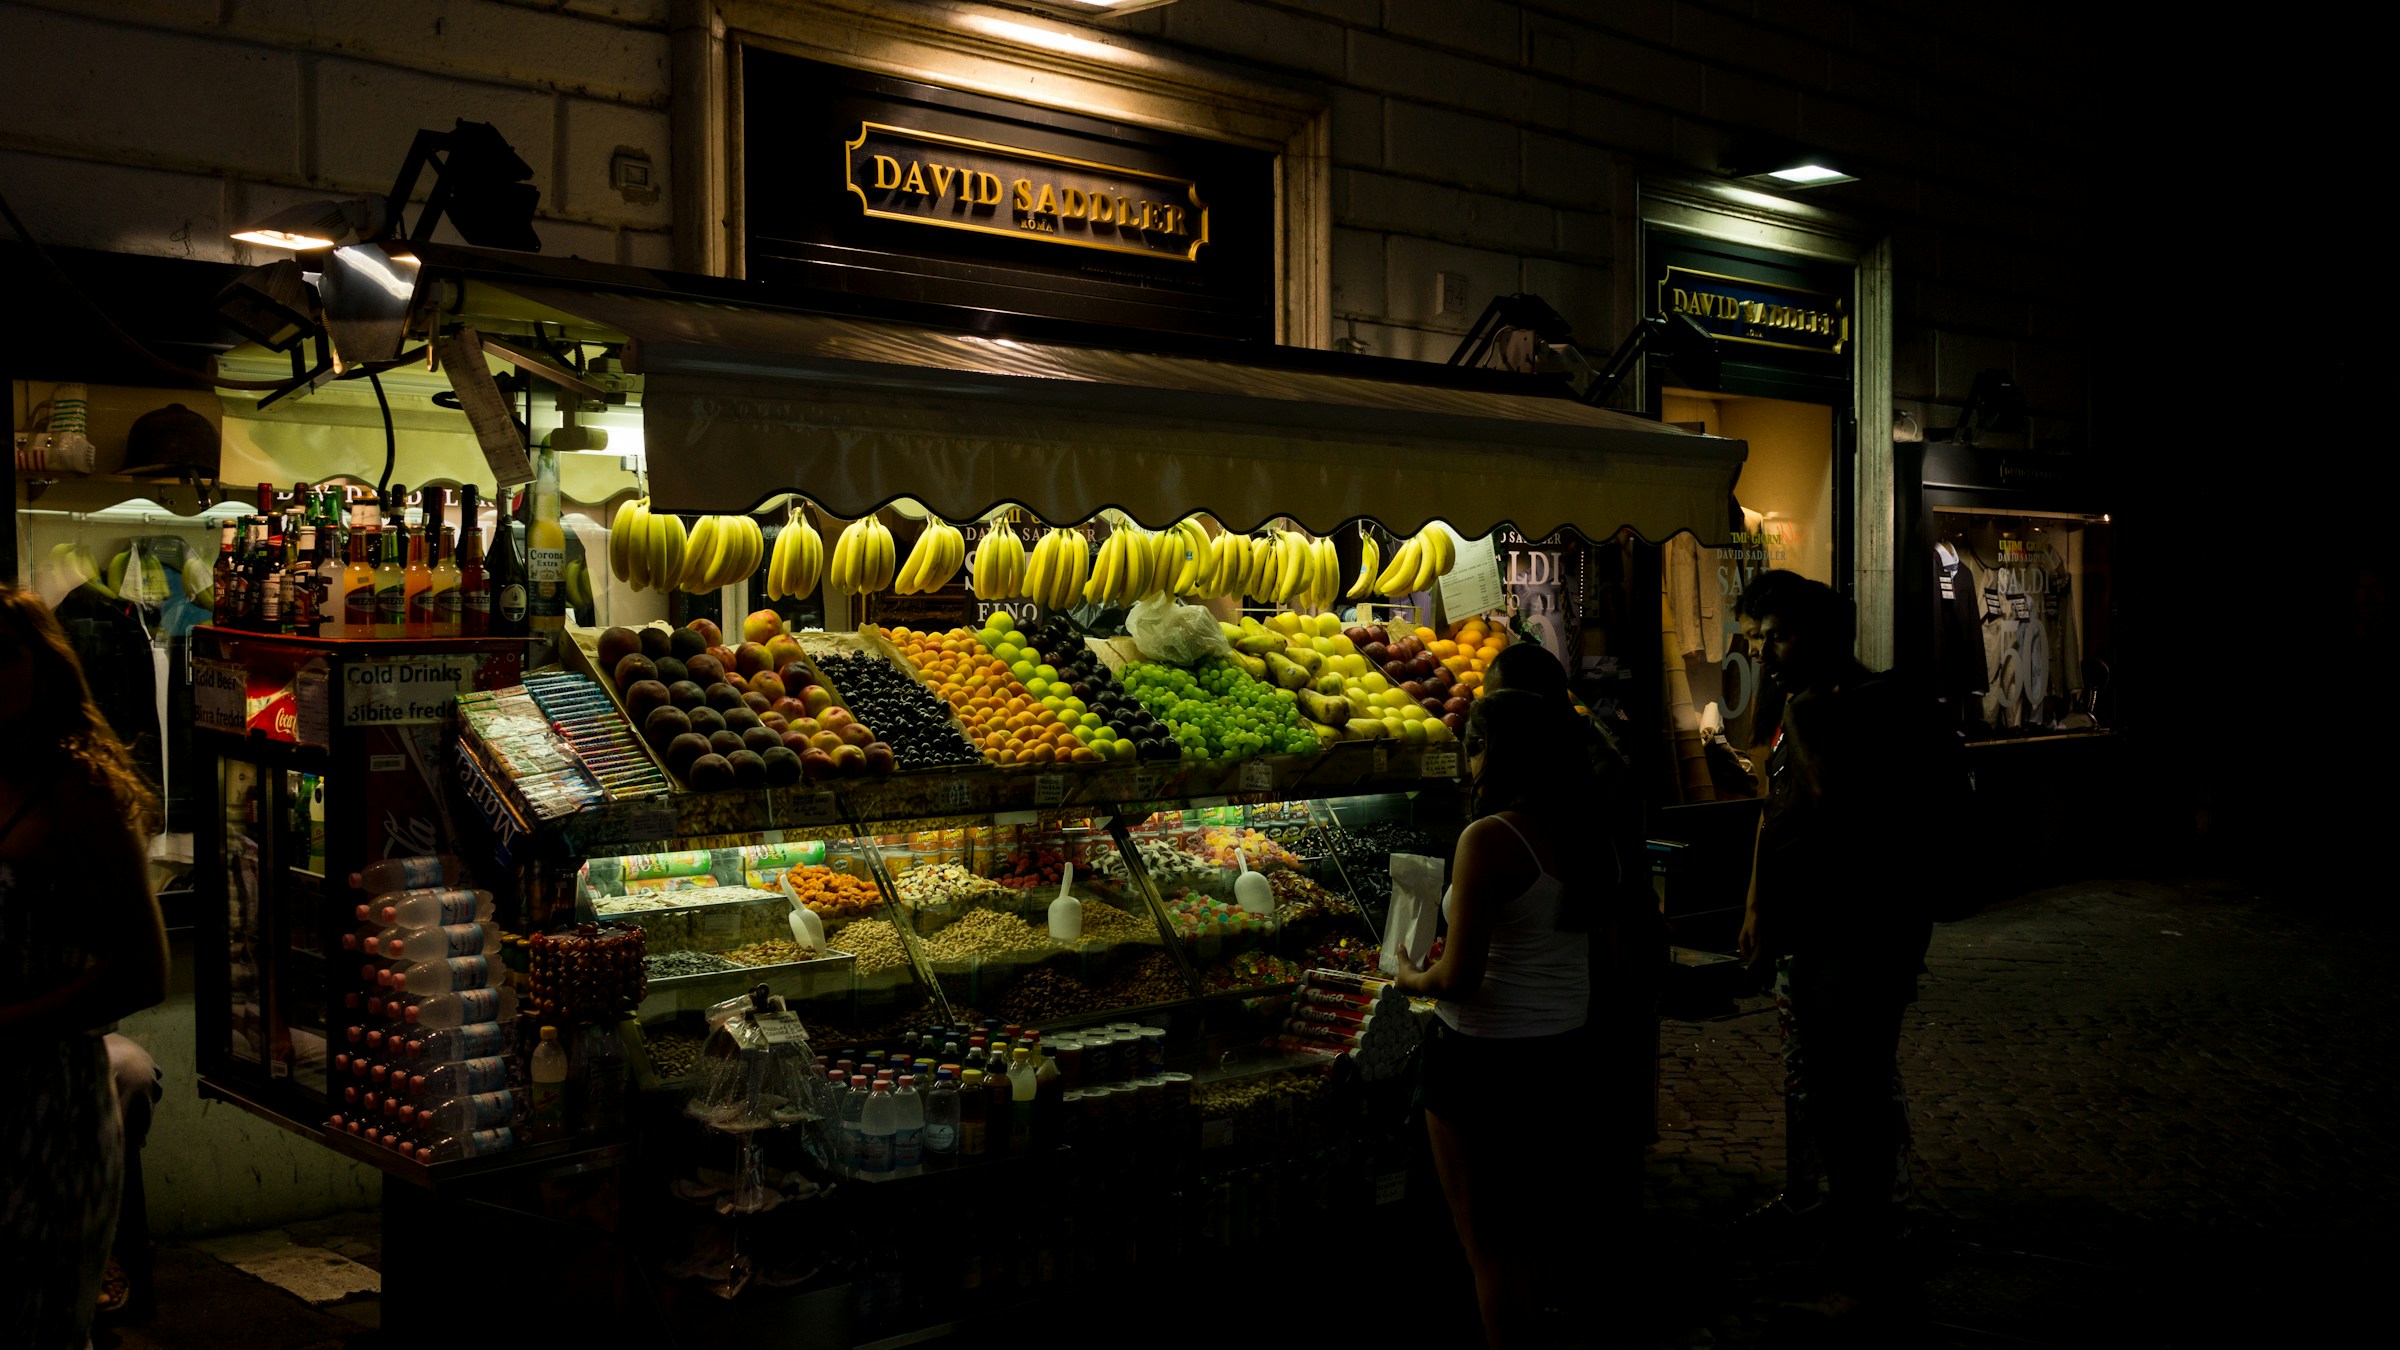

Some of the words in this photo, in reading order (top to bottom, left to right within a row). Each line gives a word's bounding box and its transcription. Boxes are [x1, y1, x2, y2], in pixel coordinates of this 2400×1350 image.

[873, 154, 1003, 206] DAVID
[1013, 178, 1190, 236] SADDLER
[1020, 217, 1054, 233] ROMA
[1672, 287, 1739, 321] DAVID
[1716, 548, 1744, 560] DAVID
[1998, 567, 2051, 594] SALDI
[195, 669, 215, 688] Cold
[217, 672, 236, 690] Beer
[347, 665, 393, 684] Cold
[399, 663, 462, 683] Drinks
[193, 704, 214, 721] Birra
[215, 707, 246, 728] fredda
